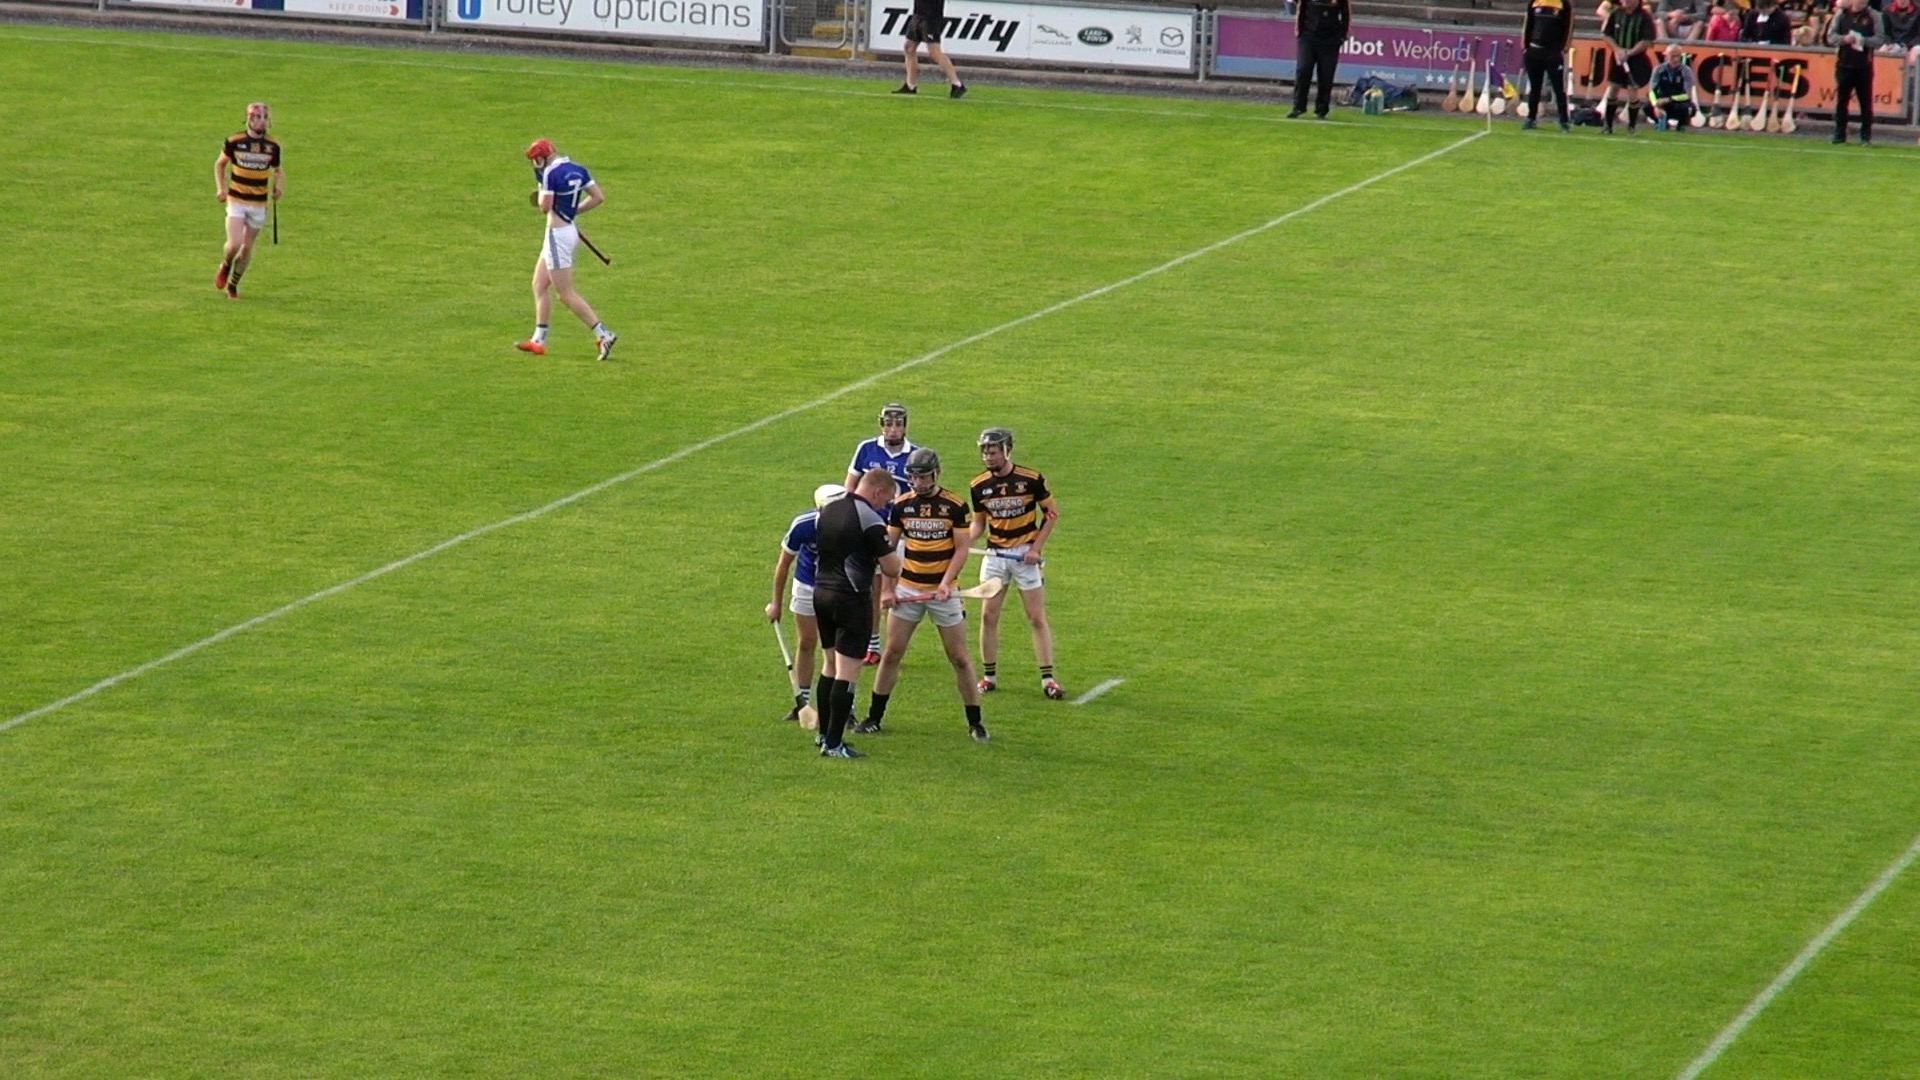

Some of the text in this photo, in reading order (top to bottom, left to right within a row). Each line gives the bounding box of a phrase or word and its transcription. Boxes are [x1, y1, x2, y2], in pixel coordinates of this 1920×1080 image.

[593, 0, 751, 28] opticians
[880, 7, 1021, 52] Tnity
[1392, 39, 1472, 62] Wexford
[568, 179, 582, 208] 7
[919, 507, 932, 517] 24
